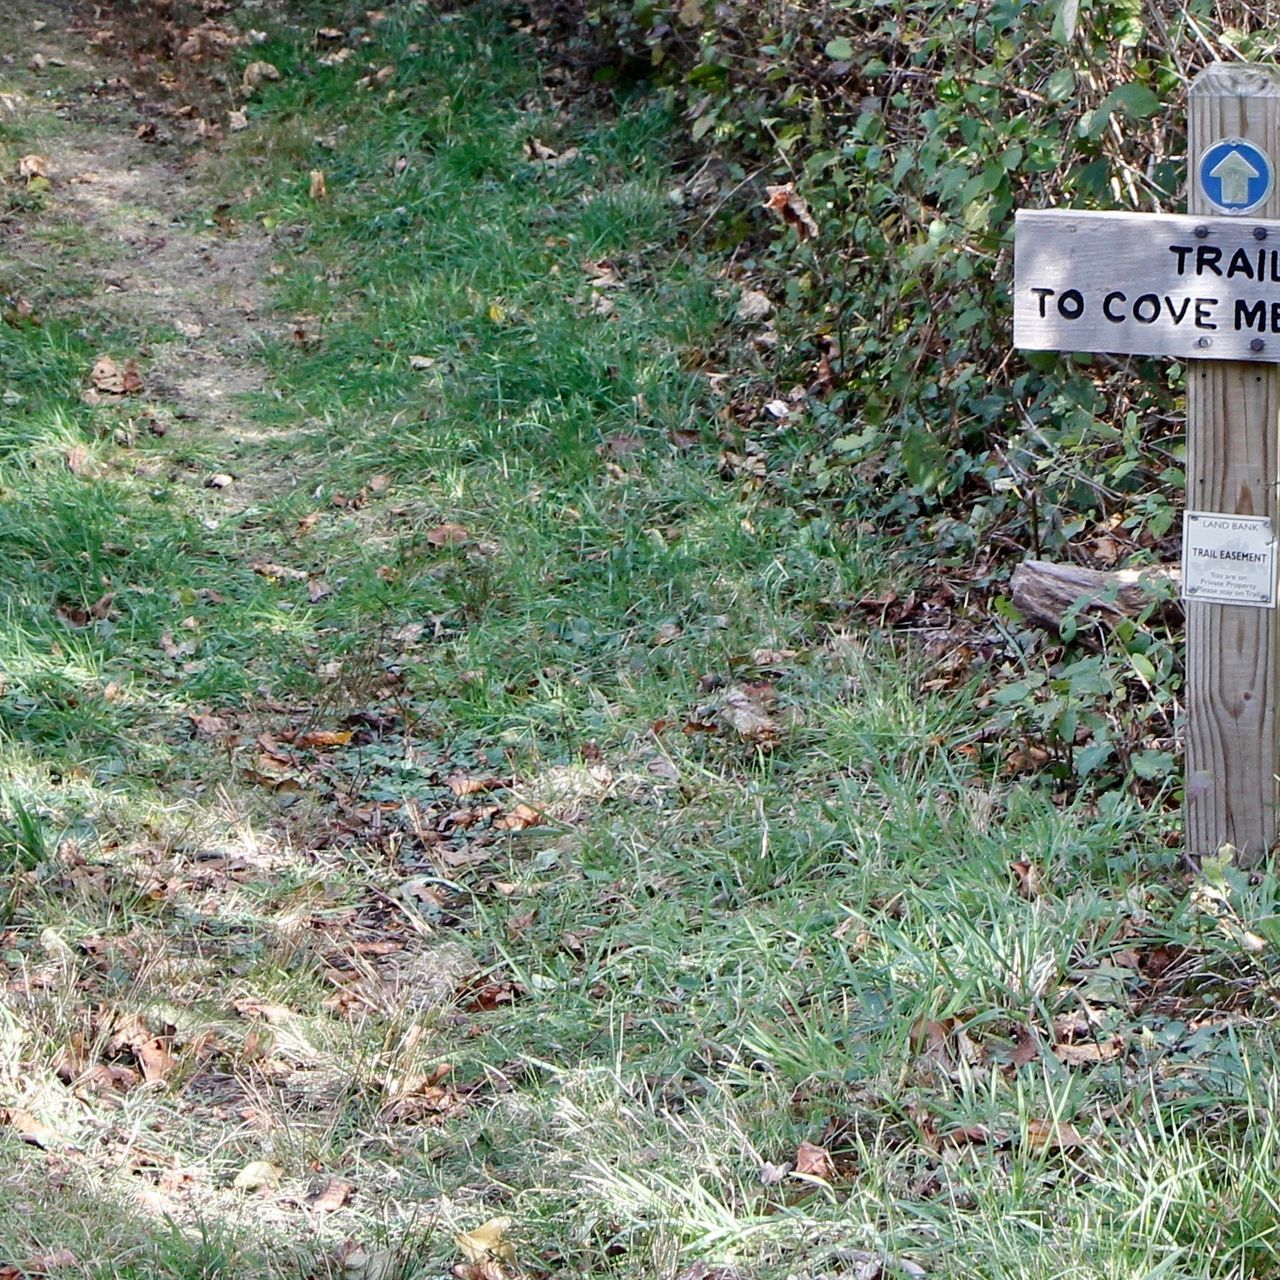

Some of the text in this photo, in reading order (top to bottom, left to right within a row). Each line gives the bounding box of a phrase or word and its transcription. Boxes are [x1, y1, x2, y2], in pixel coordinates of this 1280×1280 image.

[1031, 288, 1084, 319] TO
[1103, 291, 1219, 329] COVE
[1203, 521, 1258, 531] LAND BANK
[1193, 548, 1267, 563] TRAIL EASEMENT
[1200, 578, 1257, 590] Private Property
